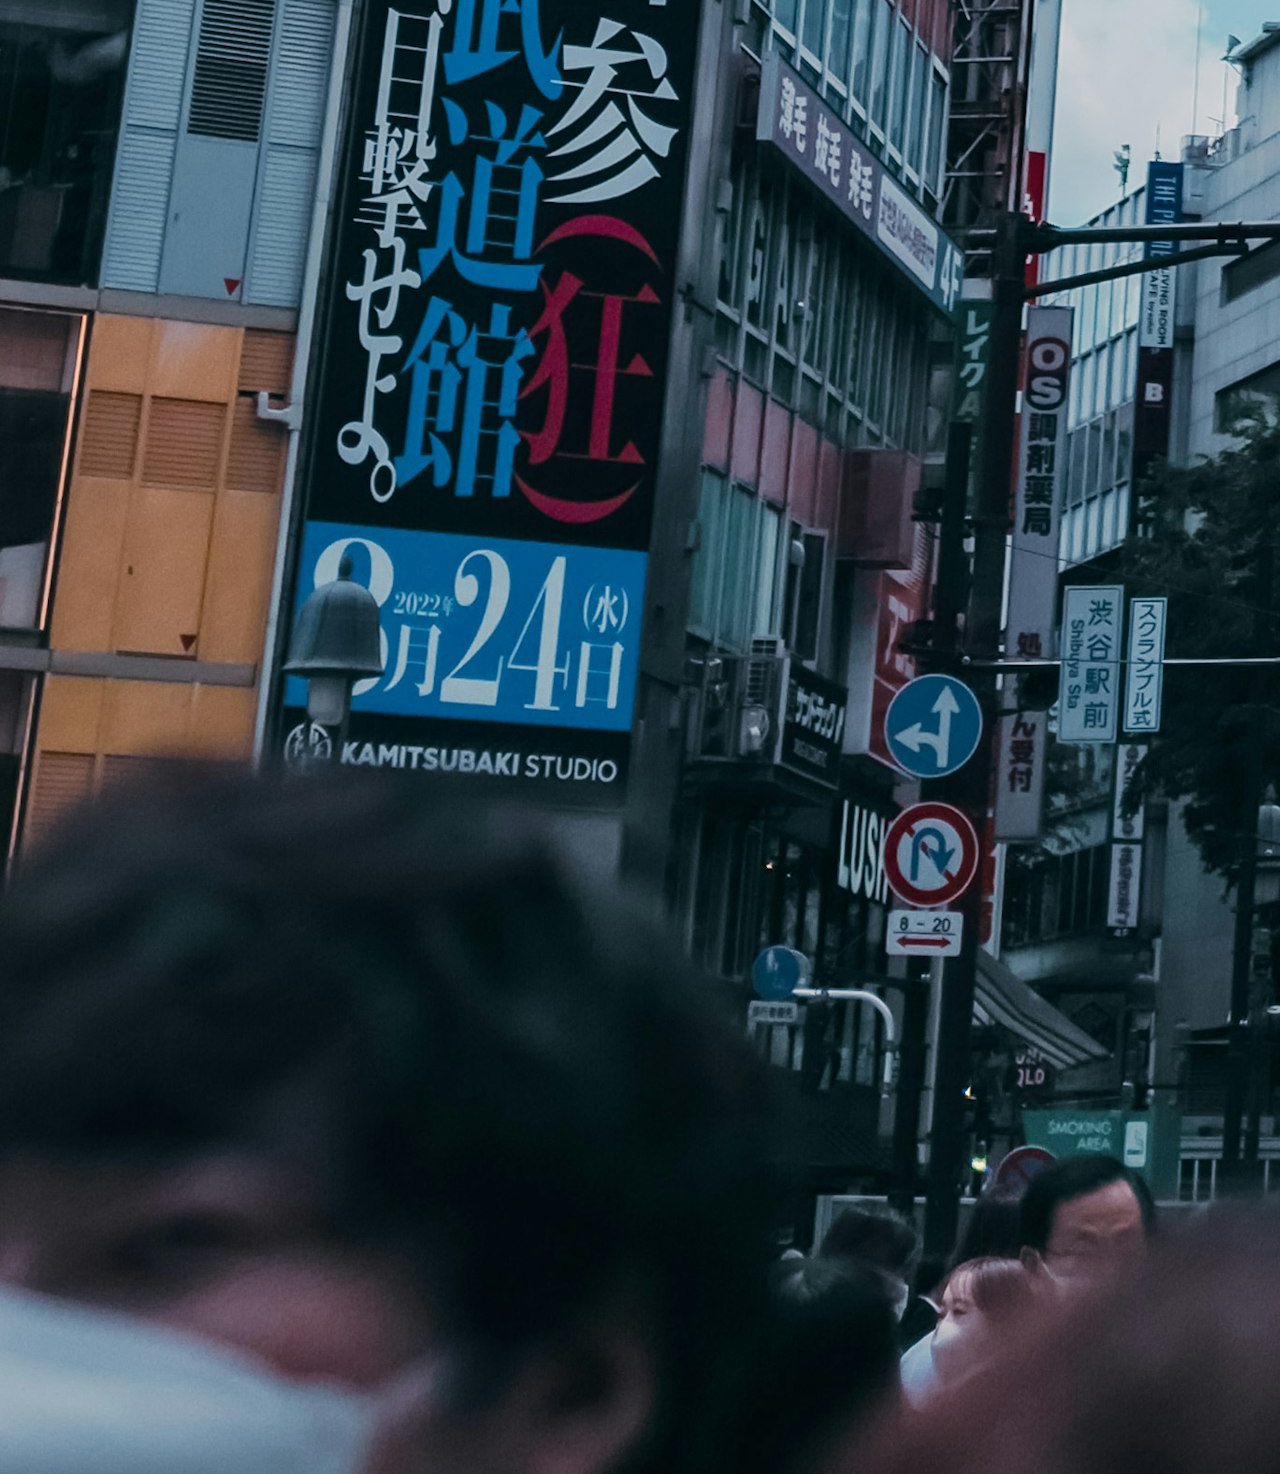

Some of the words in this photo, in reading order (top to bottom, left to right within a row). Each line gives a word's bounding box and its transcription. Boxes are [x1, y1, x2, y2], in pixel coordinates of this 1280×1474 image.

[940, 243, 963, 313] 4F
[960, 309, 990, 389] レイク
[1031, 342, 1065, 411] OS
[1022, 412, 1057, 537] 調剤薬局
[1068, 619, 1084, 678] Shibuya
[1084, 598, 1114, 729] 渋谷駅前
[1132, 603, 1157, 727] スクランブル式
[1067, 682, 1081, 713] Sta.
[341, 741, 520, 777] KAMITSUBAKI
[524, 754, 618, 783] STUDIO
[1047, 1120, 1112, 1135] SMOKING
[1076, 1137, 1112, 1151] AREA
